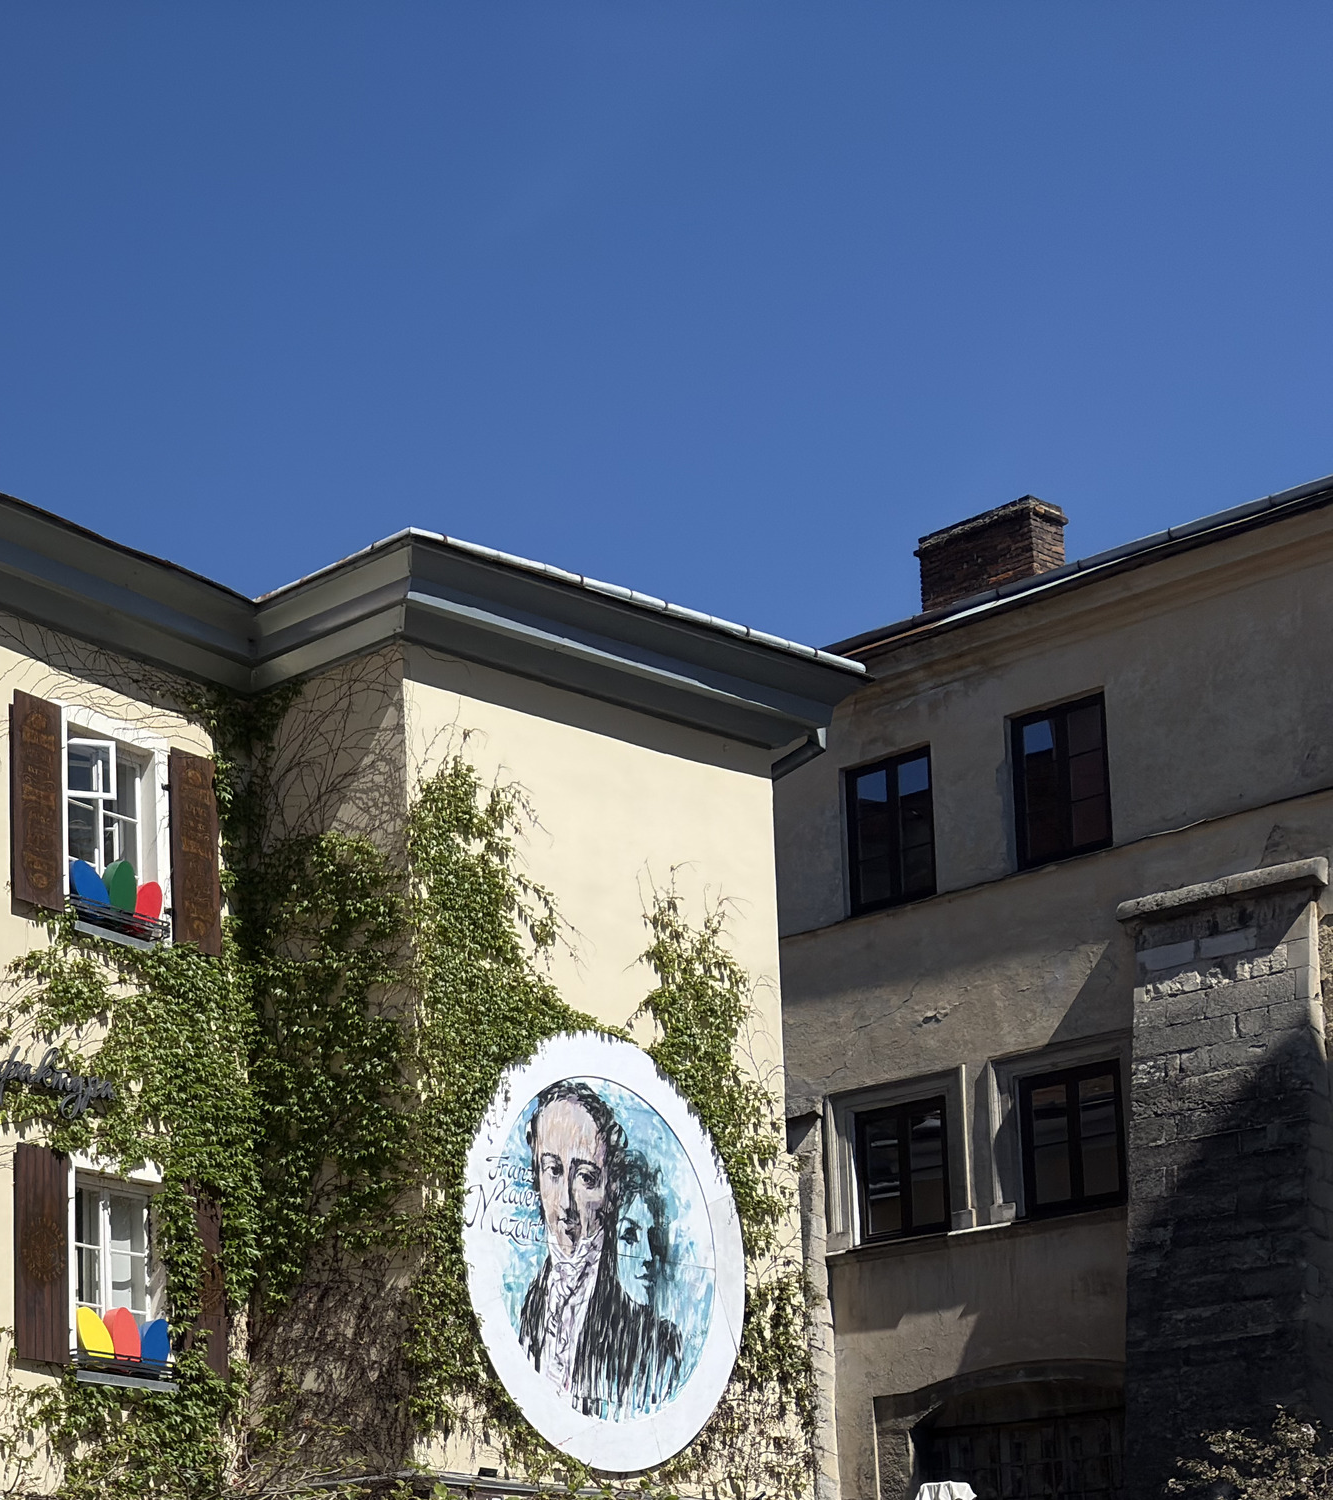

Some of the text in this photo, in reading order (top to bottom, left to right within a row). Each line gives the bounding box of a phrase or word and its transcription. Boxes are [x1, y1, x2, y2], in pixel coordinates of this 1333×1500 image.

[485, 1155, 535, 1184] Franz
[494, 1178, 541, 1208] Xaver
[464, 1184, 545, 1246] Mozart
